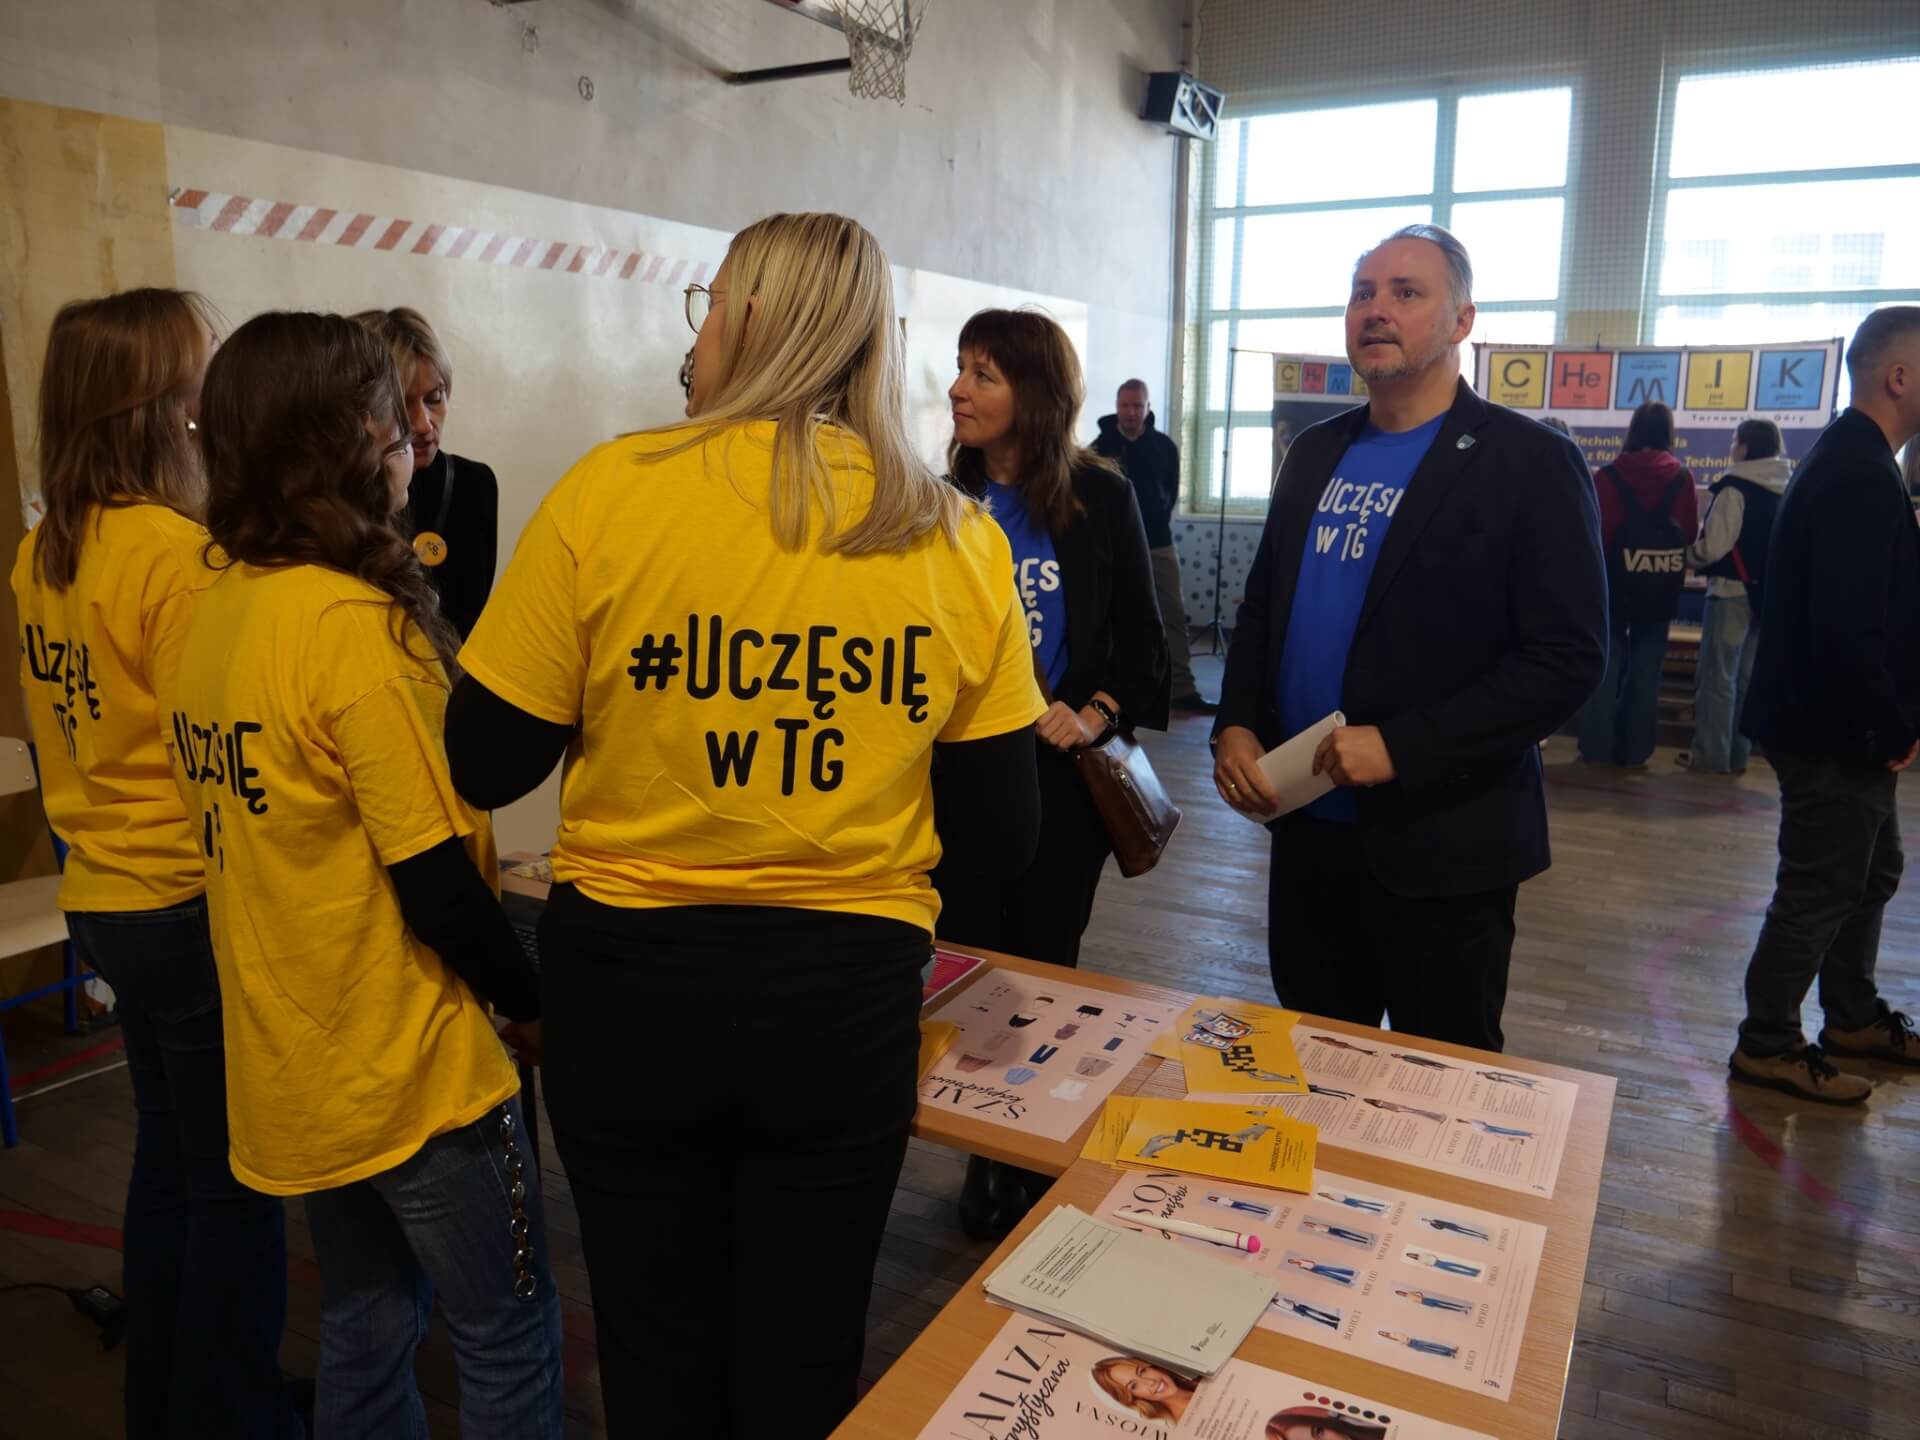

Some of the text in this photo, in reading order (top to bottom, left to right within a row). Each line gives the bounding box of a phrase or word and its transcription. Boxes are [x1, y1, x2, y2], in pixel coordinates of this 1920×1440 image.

[1503, 359, 1531, 388] C
[1561, 362, 1601, 388] He
[1779, 358, 1804, 388] K
[1341, 523, 1368, 561] TG
[1623, 548, 1683, 573] VANS
[627, 612, 933, 724] #UCZĘSIĘ
[774, 718, 845, 797] TG
[950, 1327, 1067, 1440] ALIZA
